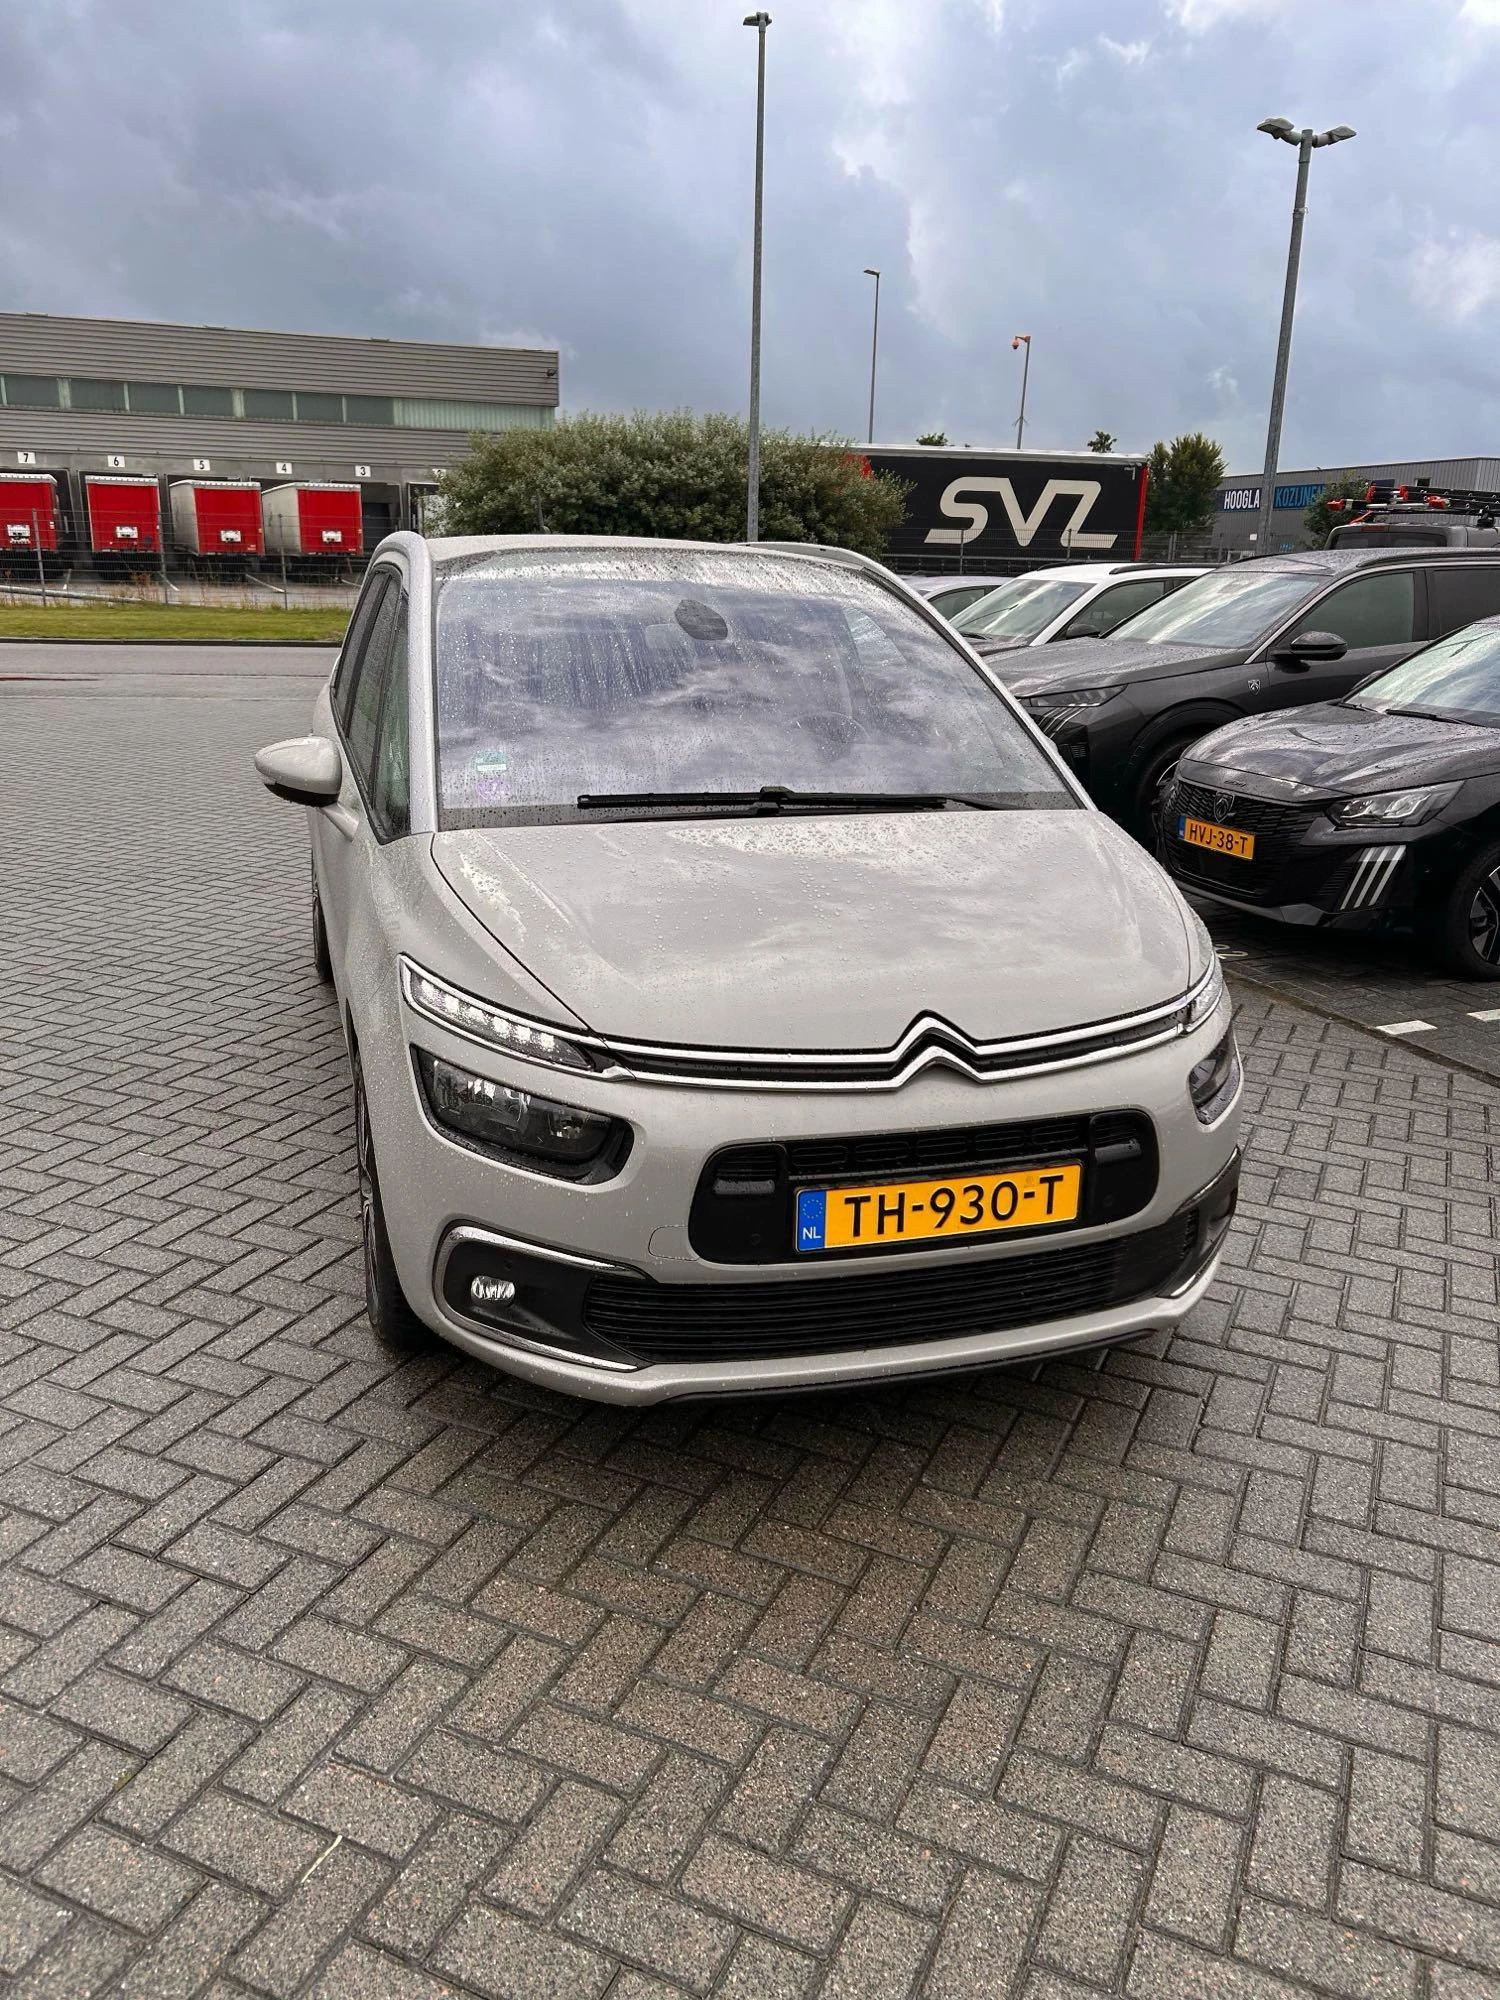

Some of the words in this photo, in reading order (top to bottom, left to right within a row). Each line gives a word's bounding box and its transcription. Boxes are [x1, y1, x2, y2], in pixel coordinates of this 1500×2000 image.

[23, 453, 29, 463] 7
[113, 456, 120, 467] 6
[199, 460, 205, 470] 5
[281, 463, 288, 473] 4
[360, 466, 367, 476] 3
[1189, 823, 1248, 854] HVJ-38-T
[802, 1227, 821, 1240] NL
[844, 1174, 1064, 1237] TH-930-T
